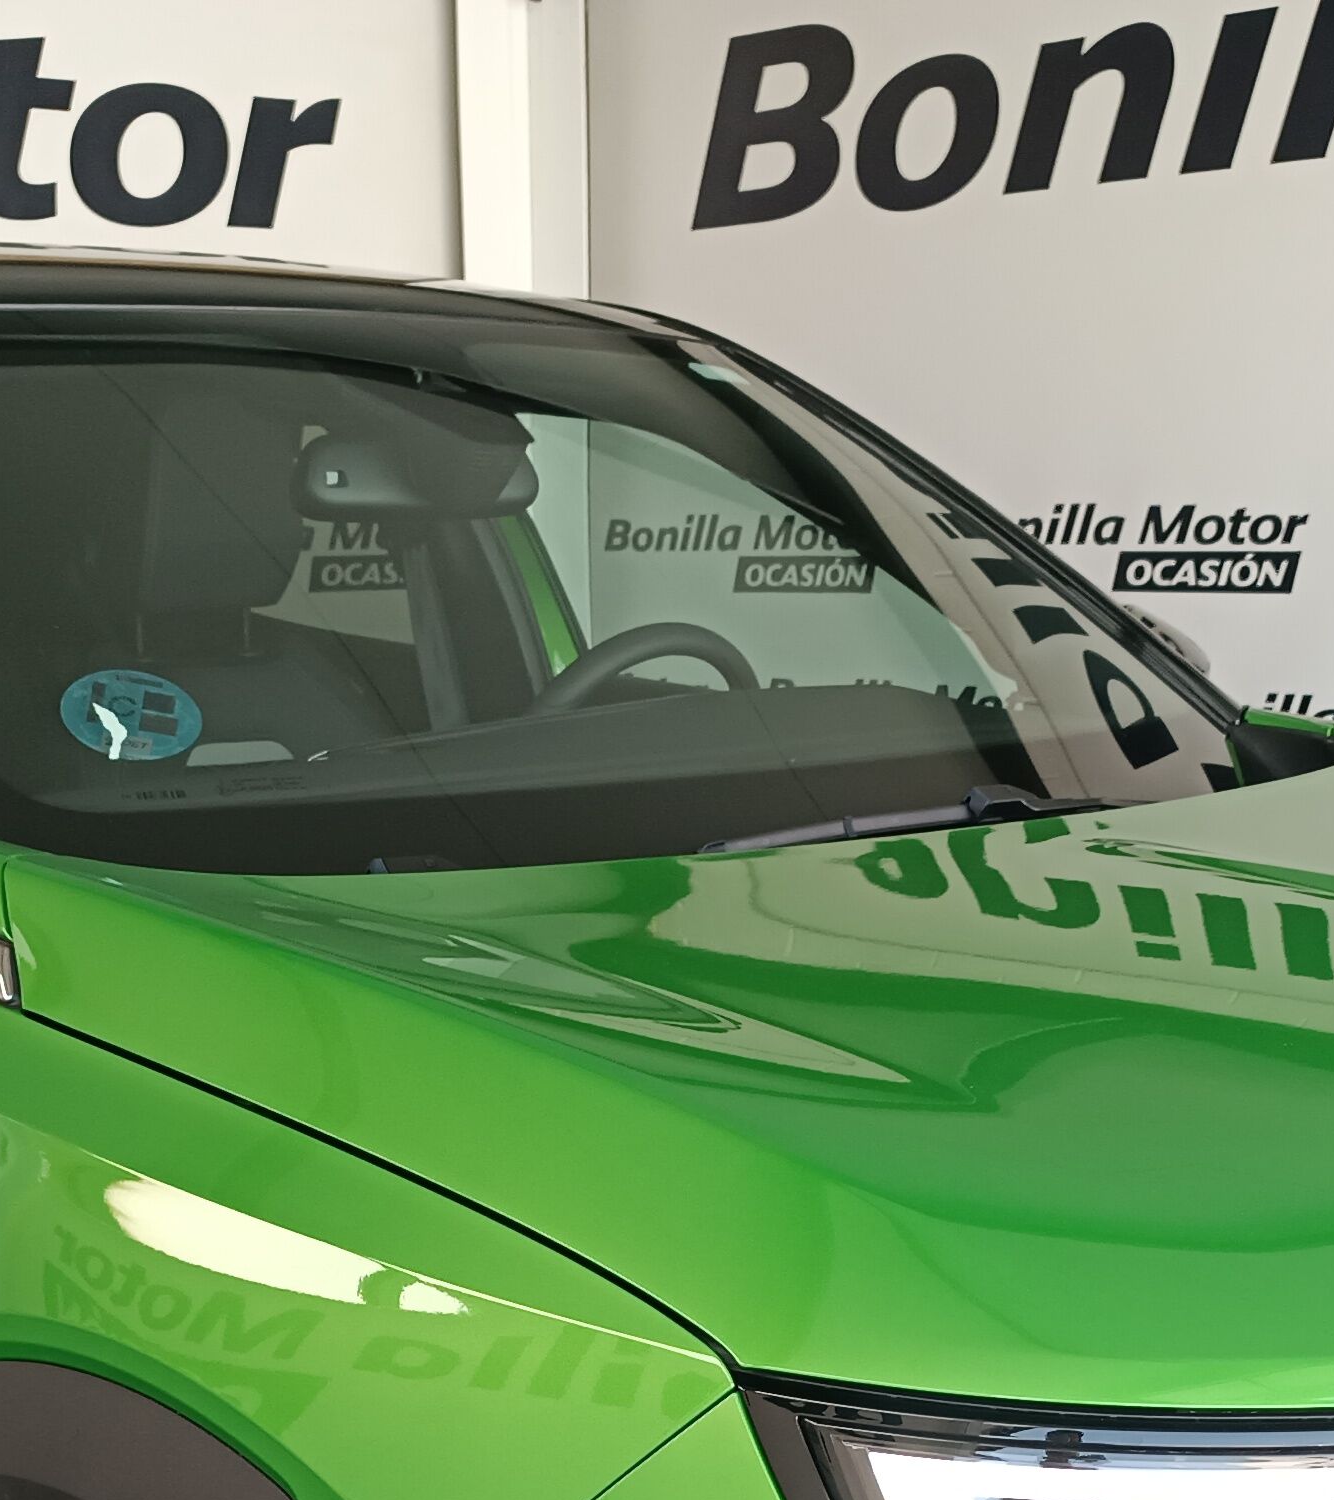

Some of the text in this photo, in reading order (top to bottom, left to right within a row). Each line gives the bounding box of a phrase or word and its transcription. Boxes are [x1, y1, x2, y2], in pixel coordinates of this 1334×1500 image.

[604, 514, 744, 553] Bonilla
[1138, 504, 1310, 546] Motor
[321, 562, 405, 587] OCAS
[744, 559, 868, 588] OCASIÓN
[1125, 554, 1290, 588] OCASIÓN
